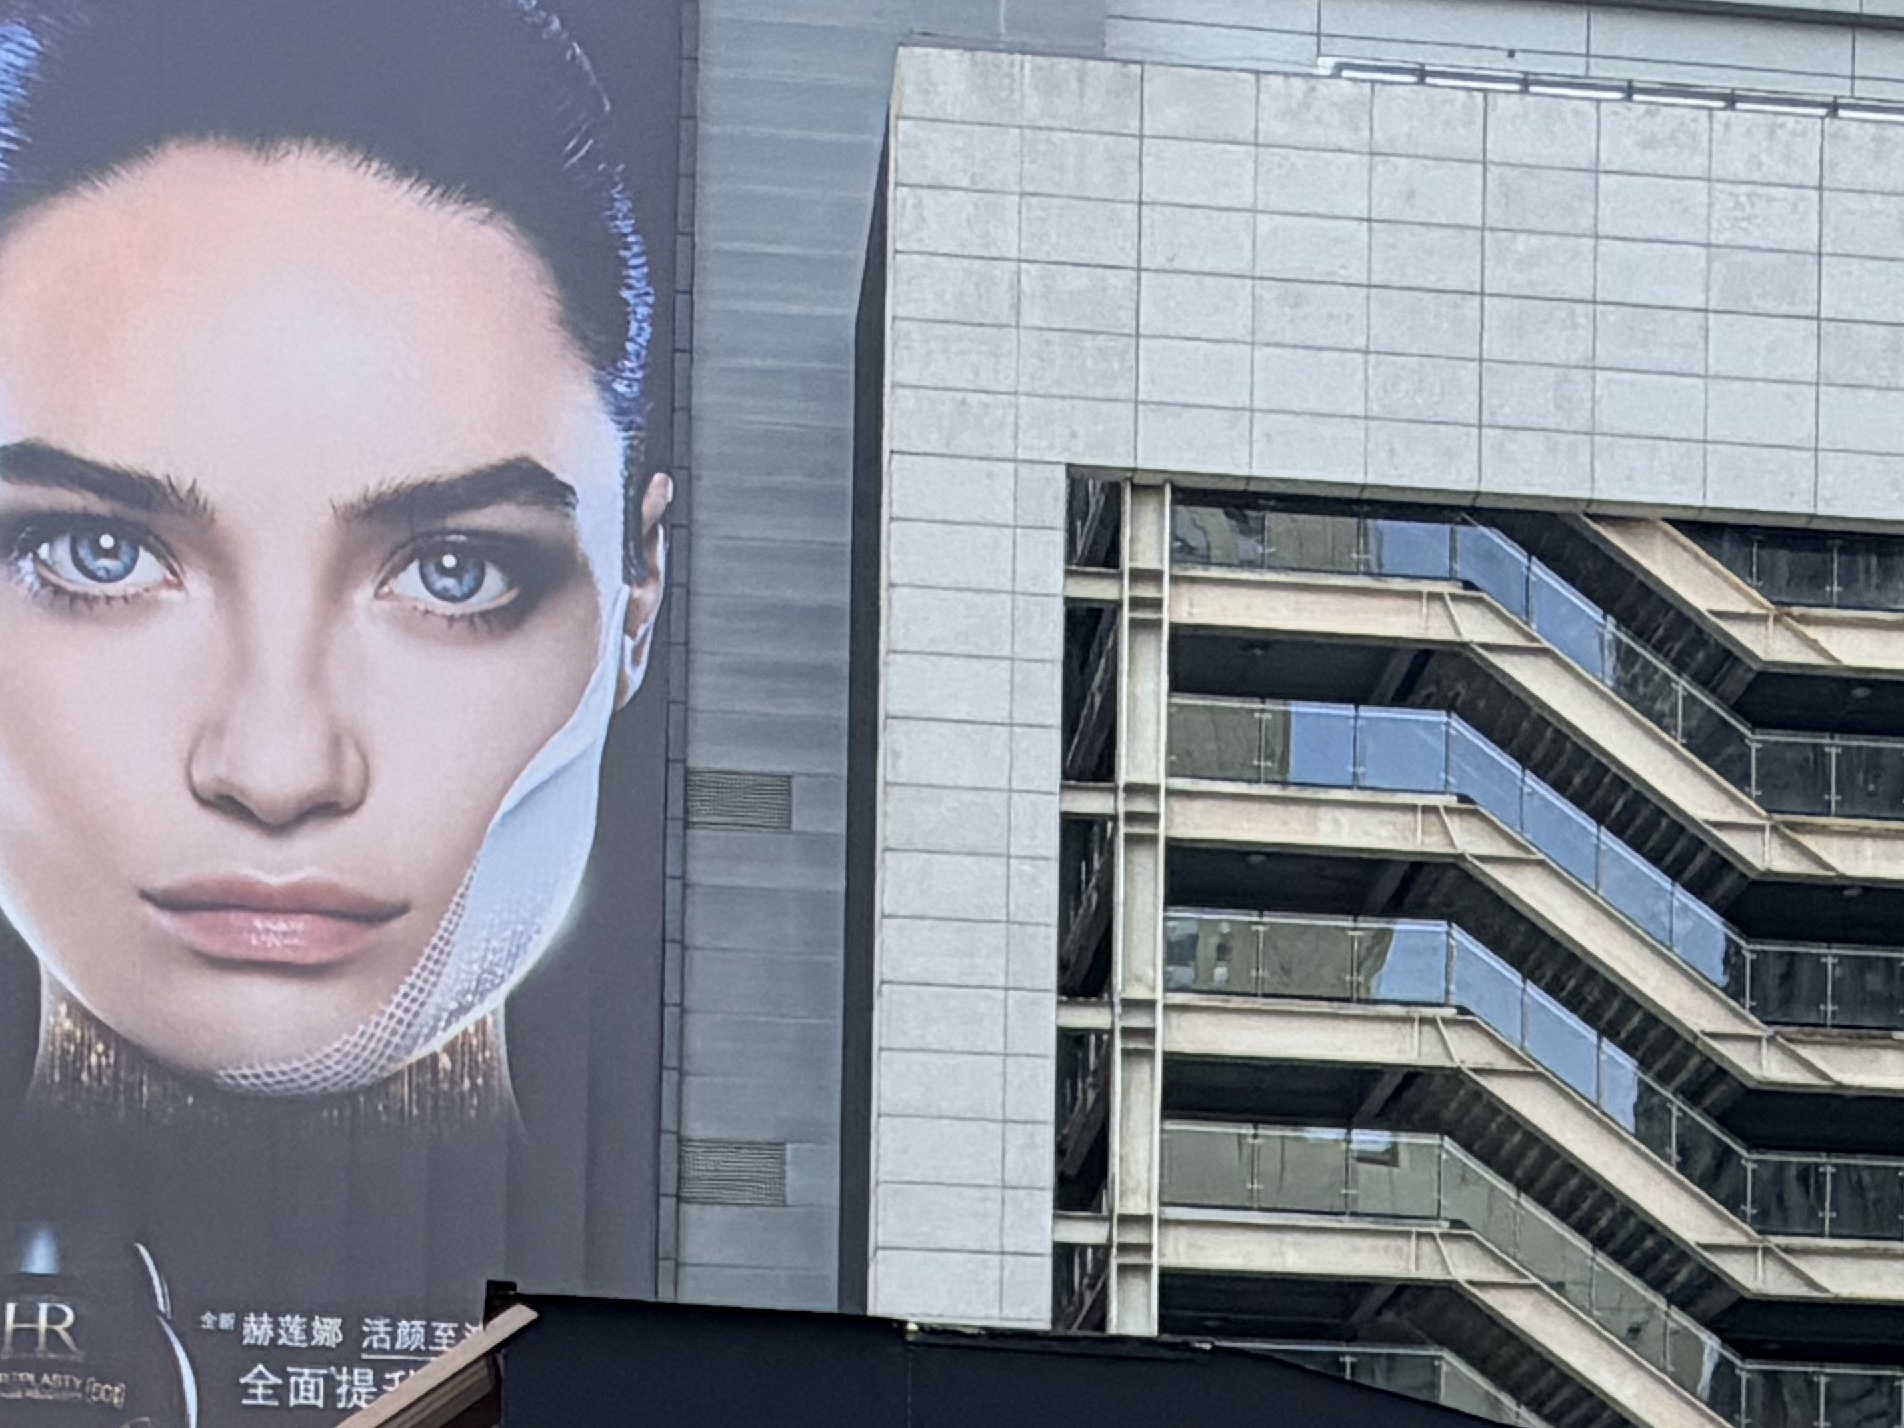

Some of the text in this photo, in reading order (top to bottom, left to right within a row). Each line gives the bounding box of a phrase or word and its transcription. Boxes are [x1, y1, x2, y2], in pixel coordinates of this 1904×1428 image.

[2, 1301, 80, 1358] HR
[242, 1312, 344, 1347] 赫莲娜
